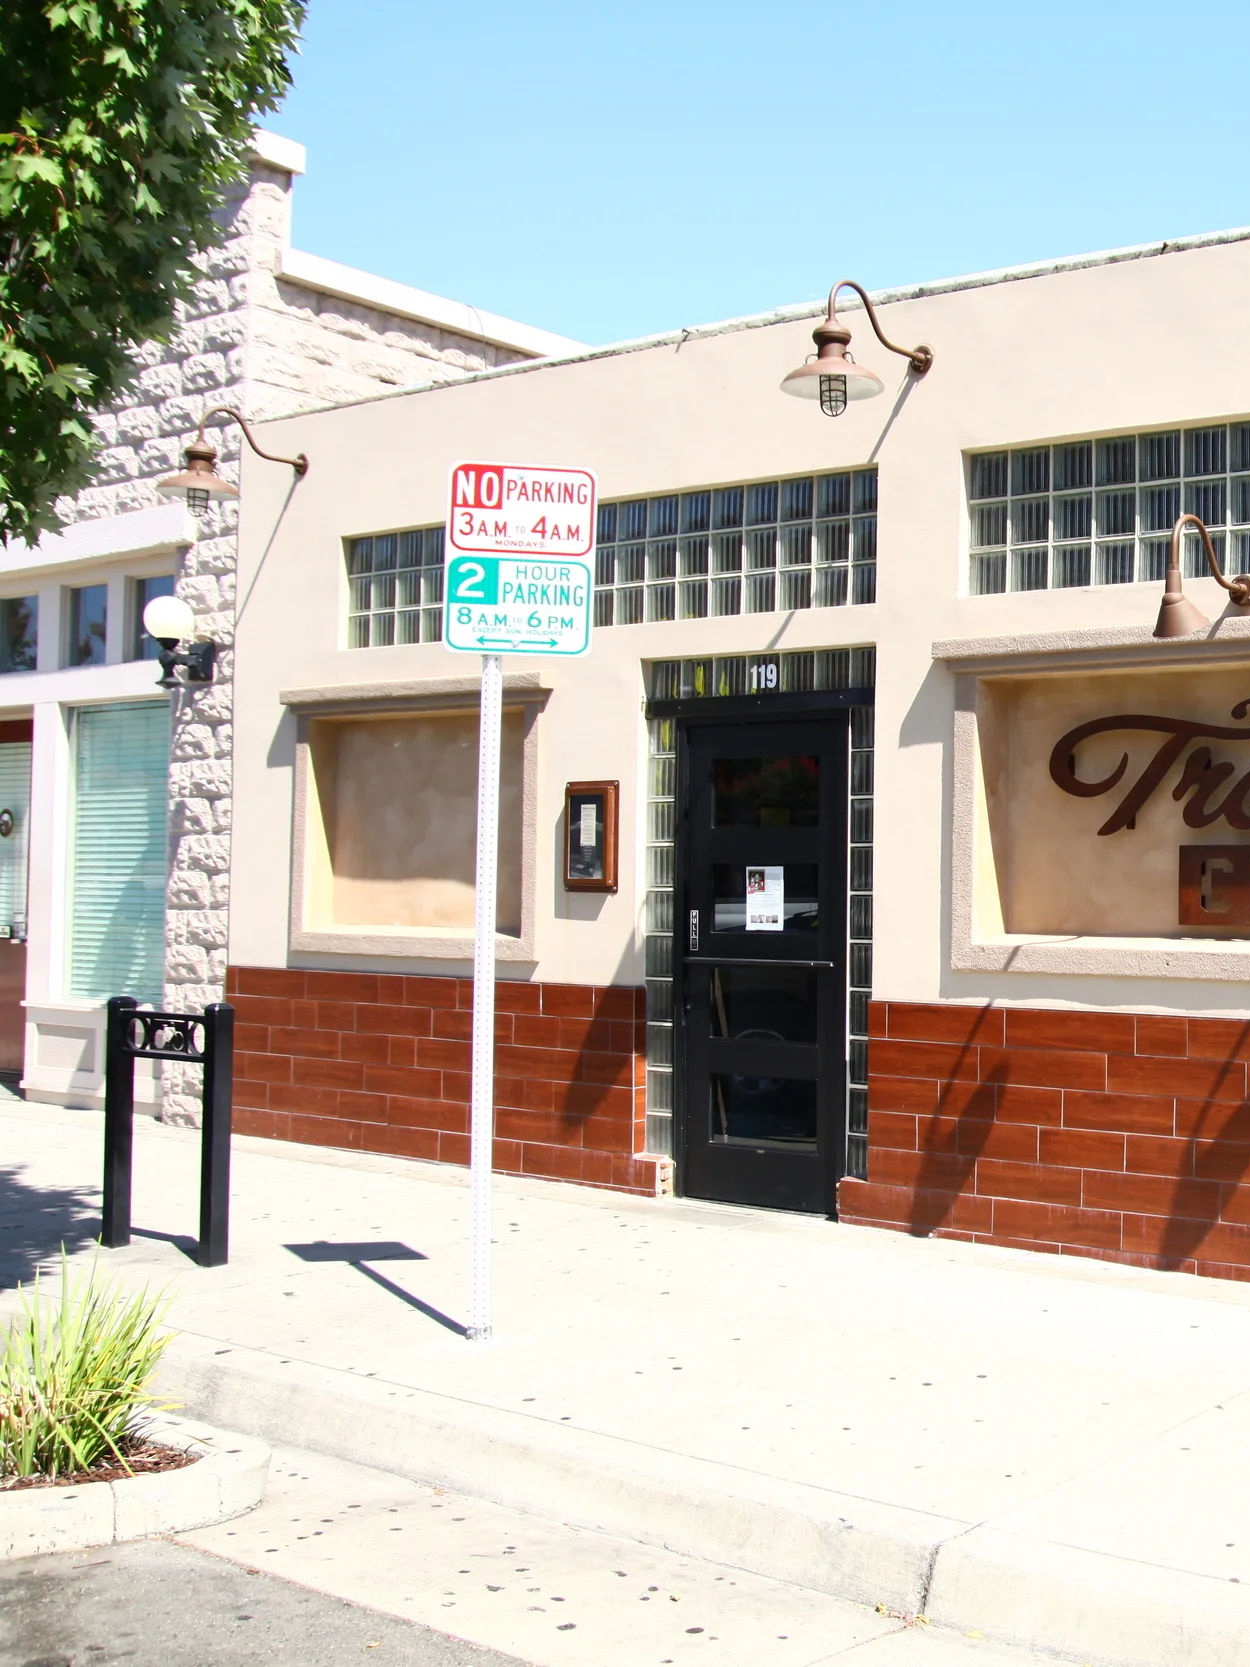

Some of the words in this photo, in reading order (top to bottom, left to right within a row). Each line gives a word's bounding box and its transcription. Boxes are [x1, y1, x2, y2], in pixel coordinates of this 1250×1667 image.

[455, 469, 501, 508] NO
[506, 479, 588, 506] PARKING
[515, 525, 526, 534] TO
[494, 539, 546, 549] MONDAYS
[455, 561, 486, 599] 2
[515, 565, 571, 582] HOUR
[502, 581, 584, 607] PARKING
[512, 617, 523, 625] TO
[471, 626, 502, 634] EXCEPT
[526, 629, 563, 637] HOLIDAYS
[750, 663, 778, 689] 119
